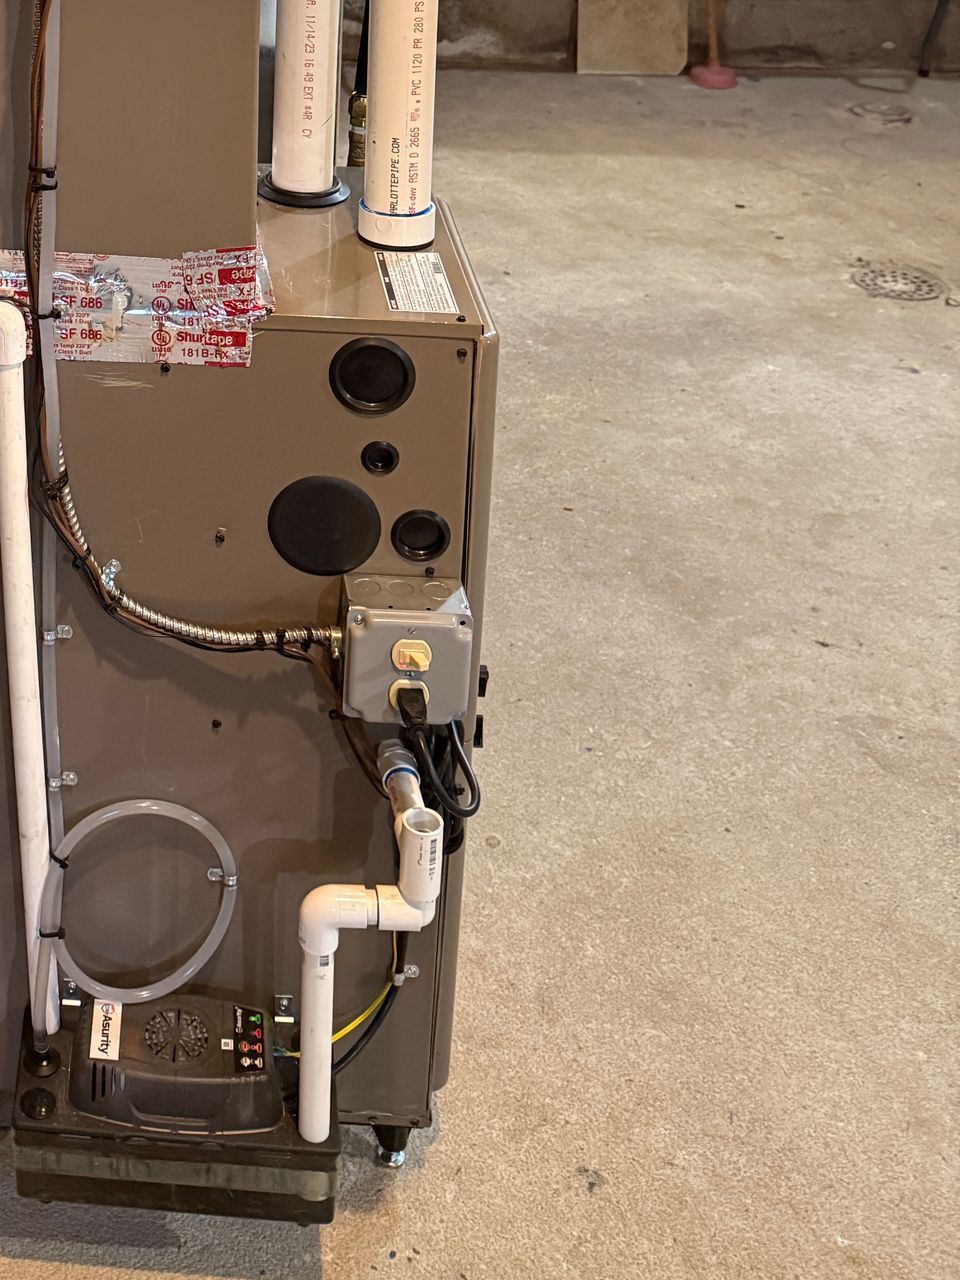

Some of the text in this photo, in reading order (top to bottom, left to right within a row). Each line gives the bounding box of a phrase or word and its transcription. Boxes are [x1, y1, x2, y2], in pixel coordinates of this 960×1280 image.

[413, 17, 424, 34] 280
[304, 15, 316, 54] 11/14/23
[413, 38, 423, 49] PR
[303, 59, 315, 83] 16:49
[412, 53, 423, 74] 1120
[303, 86, 314, 102] EXT
[412, 79, 422, 96] PVC
[301, 128, 313, 139] CY
[409, 127, 420, 148] 2665
[409, 162, 419, 183] ASTM
[197, 272, 213, 285] SF
[80, 296, 103, 309] 686
[59, 327, 103, 341] SF 686
[176, 330, 233, 347] Shurtape
[98, 1014, 113, 1055] Asurity
